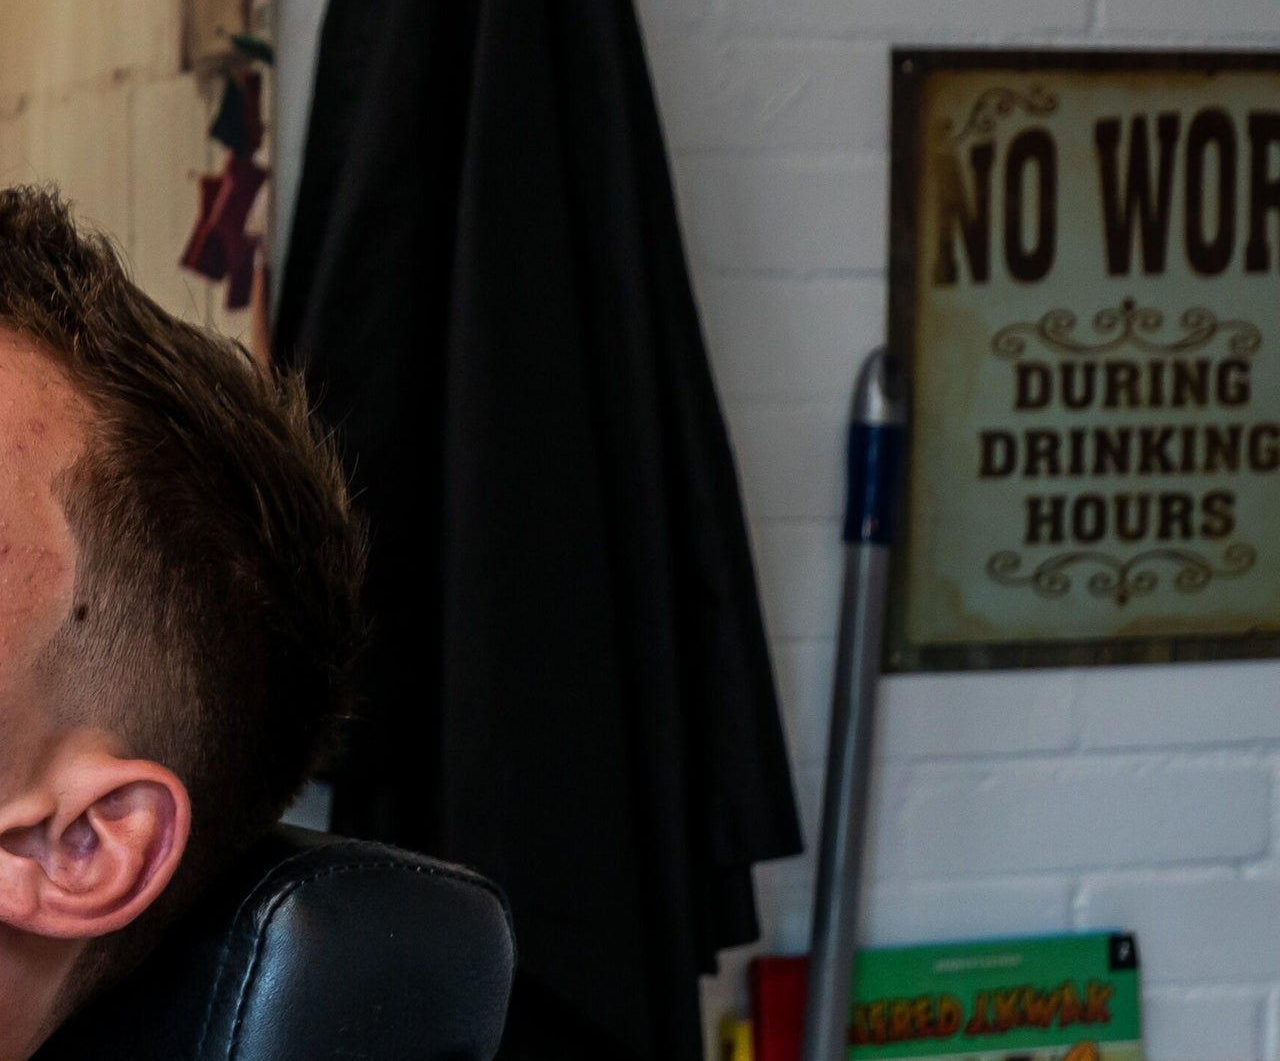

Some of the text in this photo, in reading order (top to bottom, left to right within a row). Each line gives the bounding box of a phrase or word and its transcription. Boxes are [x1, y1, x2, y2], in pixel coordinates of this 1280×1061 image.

[934, 107, 1280, 286] NO WOR
[1015, 359, 1252, 412] DURING
[978, 424, 1280, 480] DRINKING
[1024, 490, 1237, 545] HOURS
